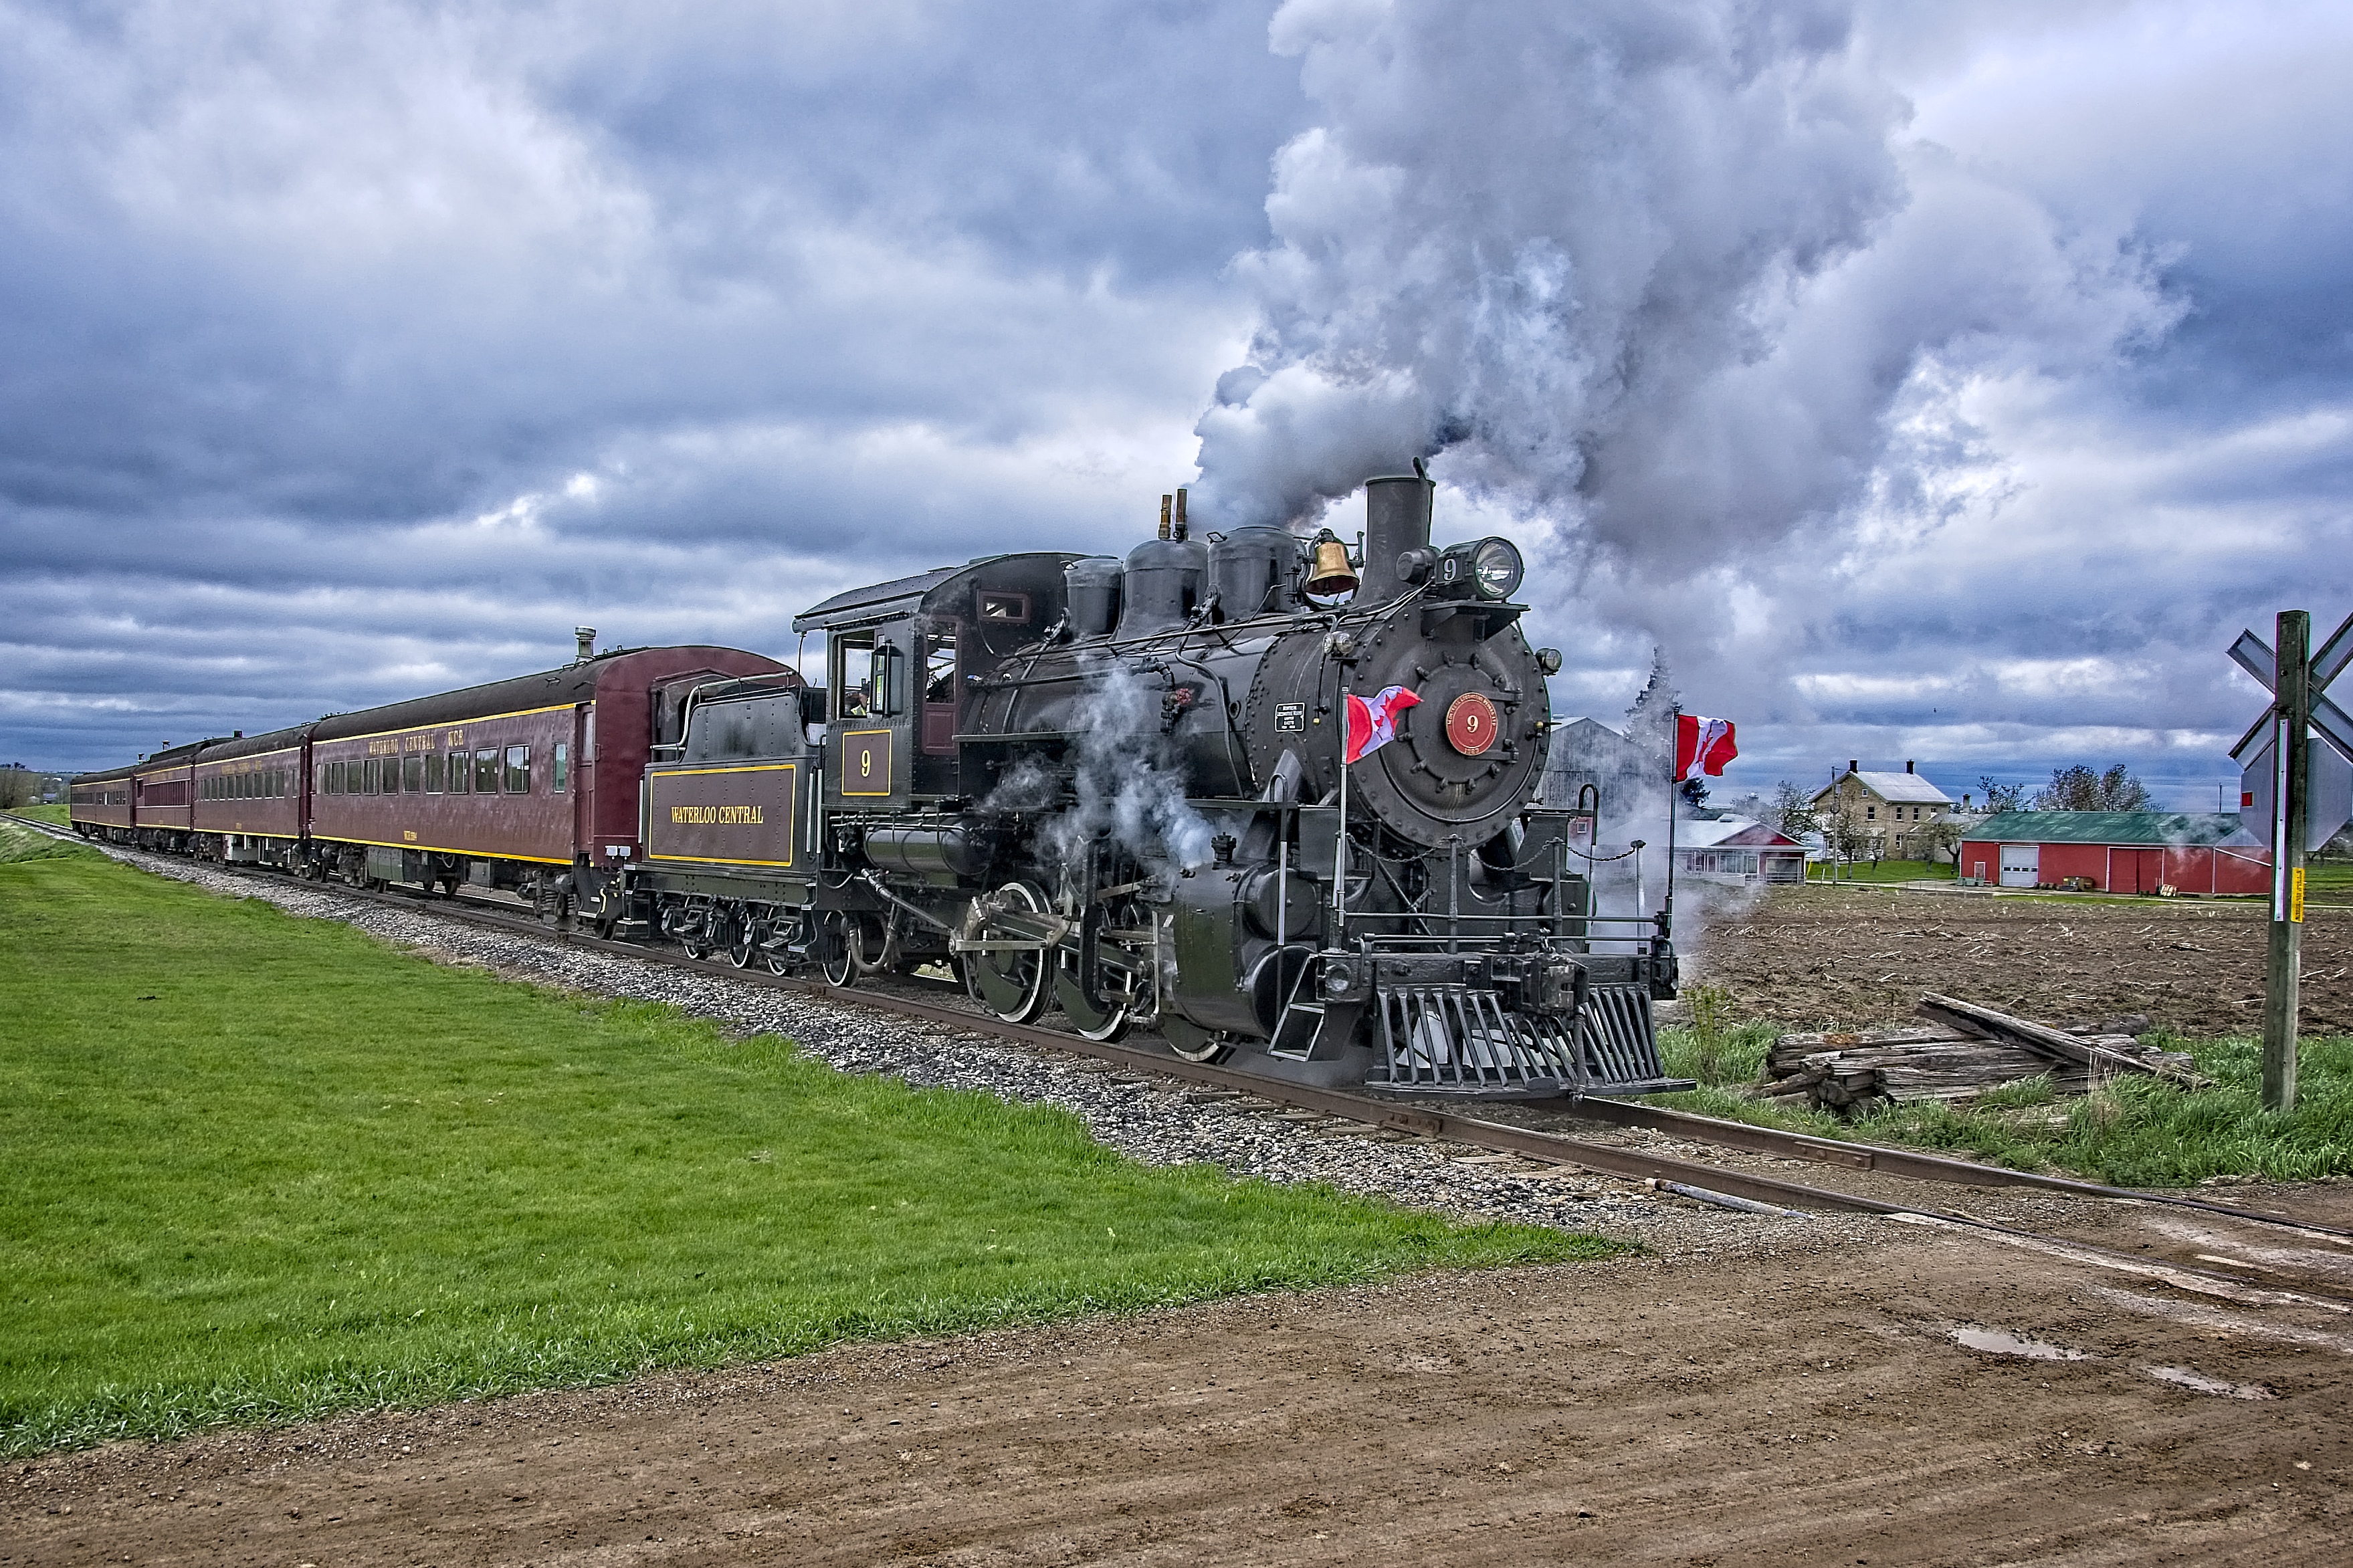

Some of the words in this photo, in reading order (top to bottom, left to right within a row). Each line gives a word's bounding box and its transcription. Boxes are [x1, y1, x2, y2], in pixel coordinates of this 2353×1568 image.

[1444, 559, 1456, 580] 9
[1467, 715, 1479, 733] 9
[369, 739, 399, 755] WATERLOO
[405, 734, 435, 752] CENTRAL
[861, 750, 871, 777] 9
[671, 806, 716, 824] WATERLOO
[718, 806, 764, 824] CENTRAL
